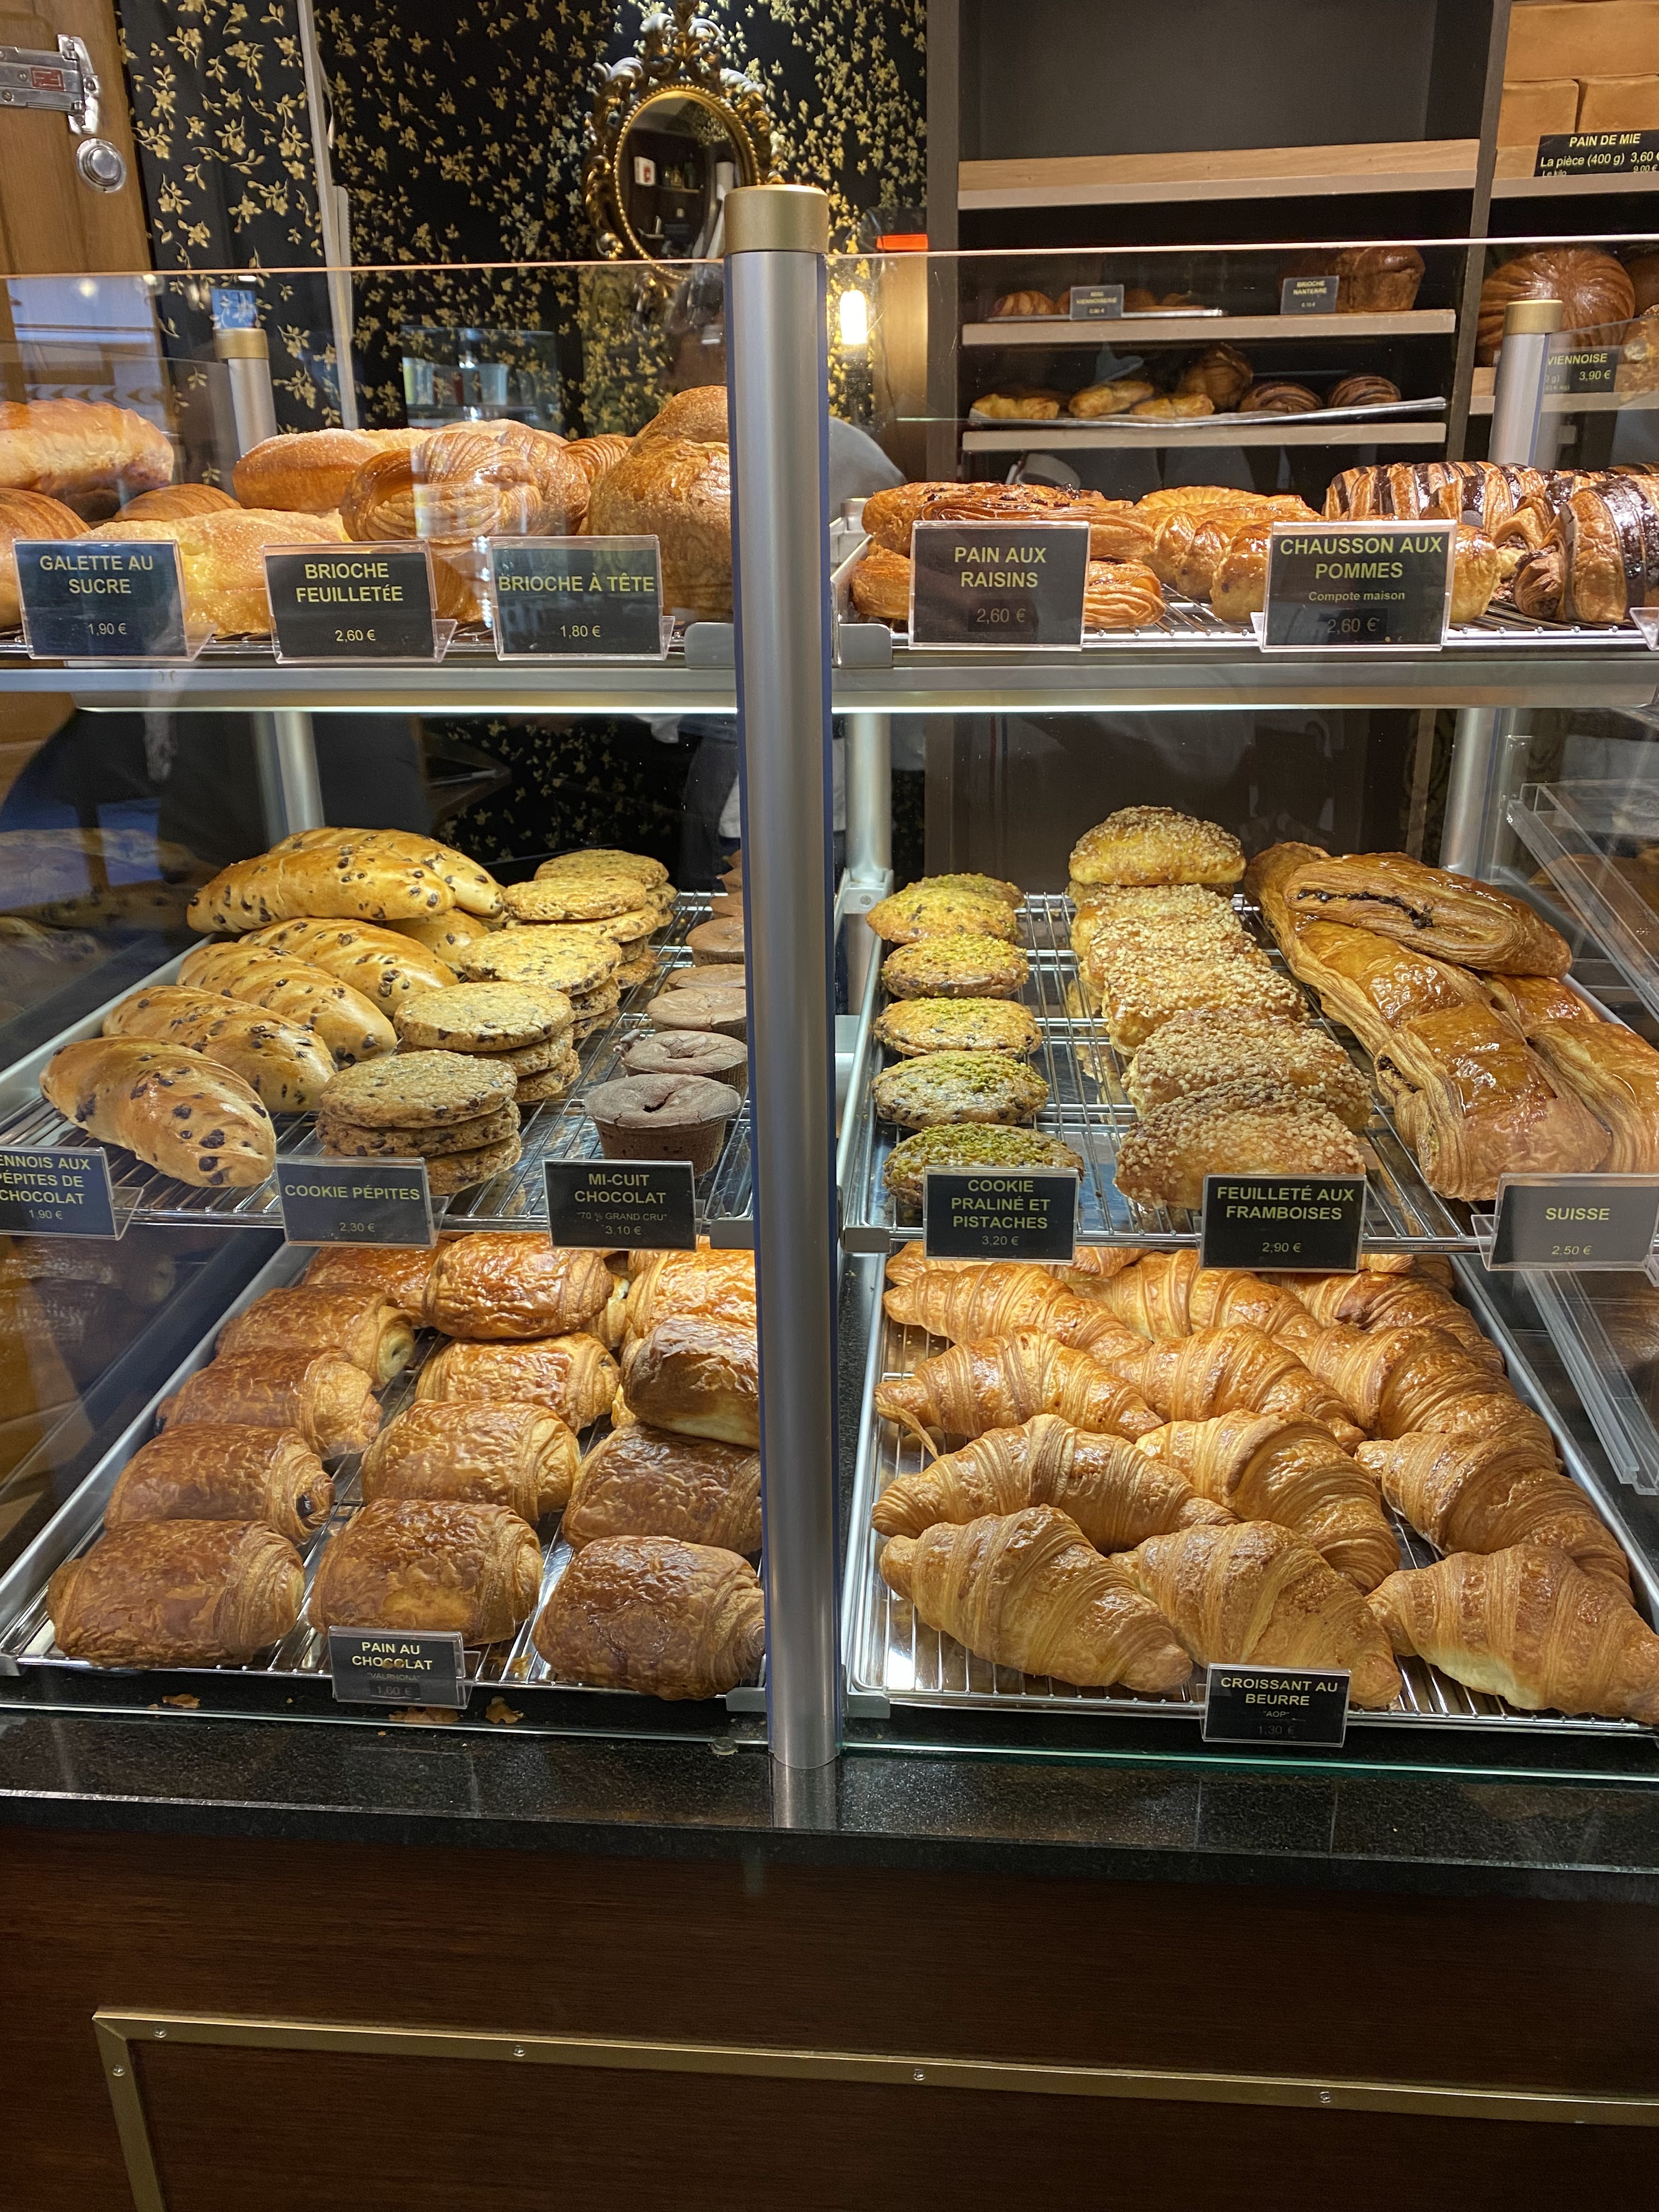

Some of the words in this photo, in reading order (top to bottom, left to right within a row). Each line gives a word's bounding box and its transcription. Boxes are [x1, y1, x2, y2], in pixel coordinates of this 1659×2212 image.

[1569, 136, 1598, 147] PAIN
[1600, 134, 1617, 145] DE
[1620, 133, 1641, 144] MIE
[1541, 157, 1554, 167] La
[1556, 155, 1584, 168] pièce
[1587, 153, 1611, 166] (400
[1613, 153, 1625, 166] g)
[1630, 151, 1654, 163] 3,60
[1548, 353, 1608, 365] VIENNOISE
[1579, 370, 1601, 381] 3,90
[1604, 369, 1611, 379] €
[1280, 537, 1394, 555] CHAUSSON
[1400, 537, 1442, 554] AUX
[955, 546, 999, 563] PAIN
[1005, 548, 1046, 563] AUX
[40, 555, 123, 571] GALETTE
[128, 555, 153, 570] AU
[305, 562, 389, 579] BRIOCHE
[1315, 562, 1403, 579] POMMES
[69, 579, 131, 594] SUCRE
[498, 575, 583, 592] BRIOCHE
[589, 572, 602, 592] À
[607, 573, 654, 592] TÊTE
[961, 571, 1038, 588] RAISINS
[296, 584, 403, 602] FEUILLETÉE
[1308, 591, 1360, 603] Compote
[1363, 591, 1405, 601] maison
[976, 608, 1009, 624] 2,60
[1017, 608, 1026, 623] €
[88, 623, 115, 636] 1,90
[118, 623, 127, 635] €
[560, 625, 588, 639] 1,80
[592, 625, 601, 637] €
[1327, 618, 1361, 635] 2,60
[1366, 617, 1380, 631] €
[335, 629, 363, 642] 2,60
[367, 629, 376, 641] €
[58, 1157, 91, 1170] AUX
[0, 1170, 58, 1186] ÉPITES
[62, 1175, 84, 1187] DE
[589, 1173, 650, 1186] MI-CUIT
[285, 1184, 348, 1198] COOKIE
[352, 1184, 420, 1200] PÉPITES
[968, 1180, 1034, 1193] COOKIE
[1217, 1185, 1312, 1201] FEUILLETÉ
[1317, 1188, 1355, 1201] AUX
[0, 1189, 84, 1204] CHOCOLAT
[574, 1190, 666, 1204] CHOCOLAT
[951, 1196, 1024, 1211] PRALINÉ
[1029, 1199, 1051, 1211] ET
[55, 1210, 63, 1220] €
[1226, 1205, 1342, 1220] FRAMBOISES
[1545, 1207, 1610, 1221] SUISSE
[340, 1222, 364, 1233] 2,30
[368, 1223, 375, 1232] €
[953, 1215, 1048, 1229] PISTACHES
[605, 1226, 630, 1235] 3,10
[634, 1226, 641, 1235] €
[981, 1236, 1007, 1246] 3,20
[1012, 1236, 1019, 1245] €
[1262, 1242, 1289, 1253] 2,90
[1293, 1243, 1301, 1252] €
[1551, 1245, 1579, 1256] 2,50
[1583, 1245, 1592, 1255] €
[362, 1641, 395, 1653] PAIN
[400, 1645, 420, 1655] AU
[1221, 1677, 1312, 1691] CROISSANT
[1315, 1681, 1338, 1692] AU
[1245, 1694, 1310, 1706] BEURRE
